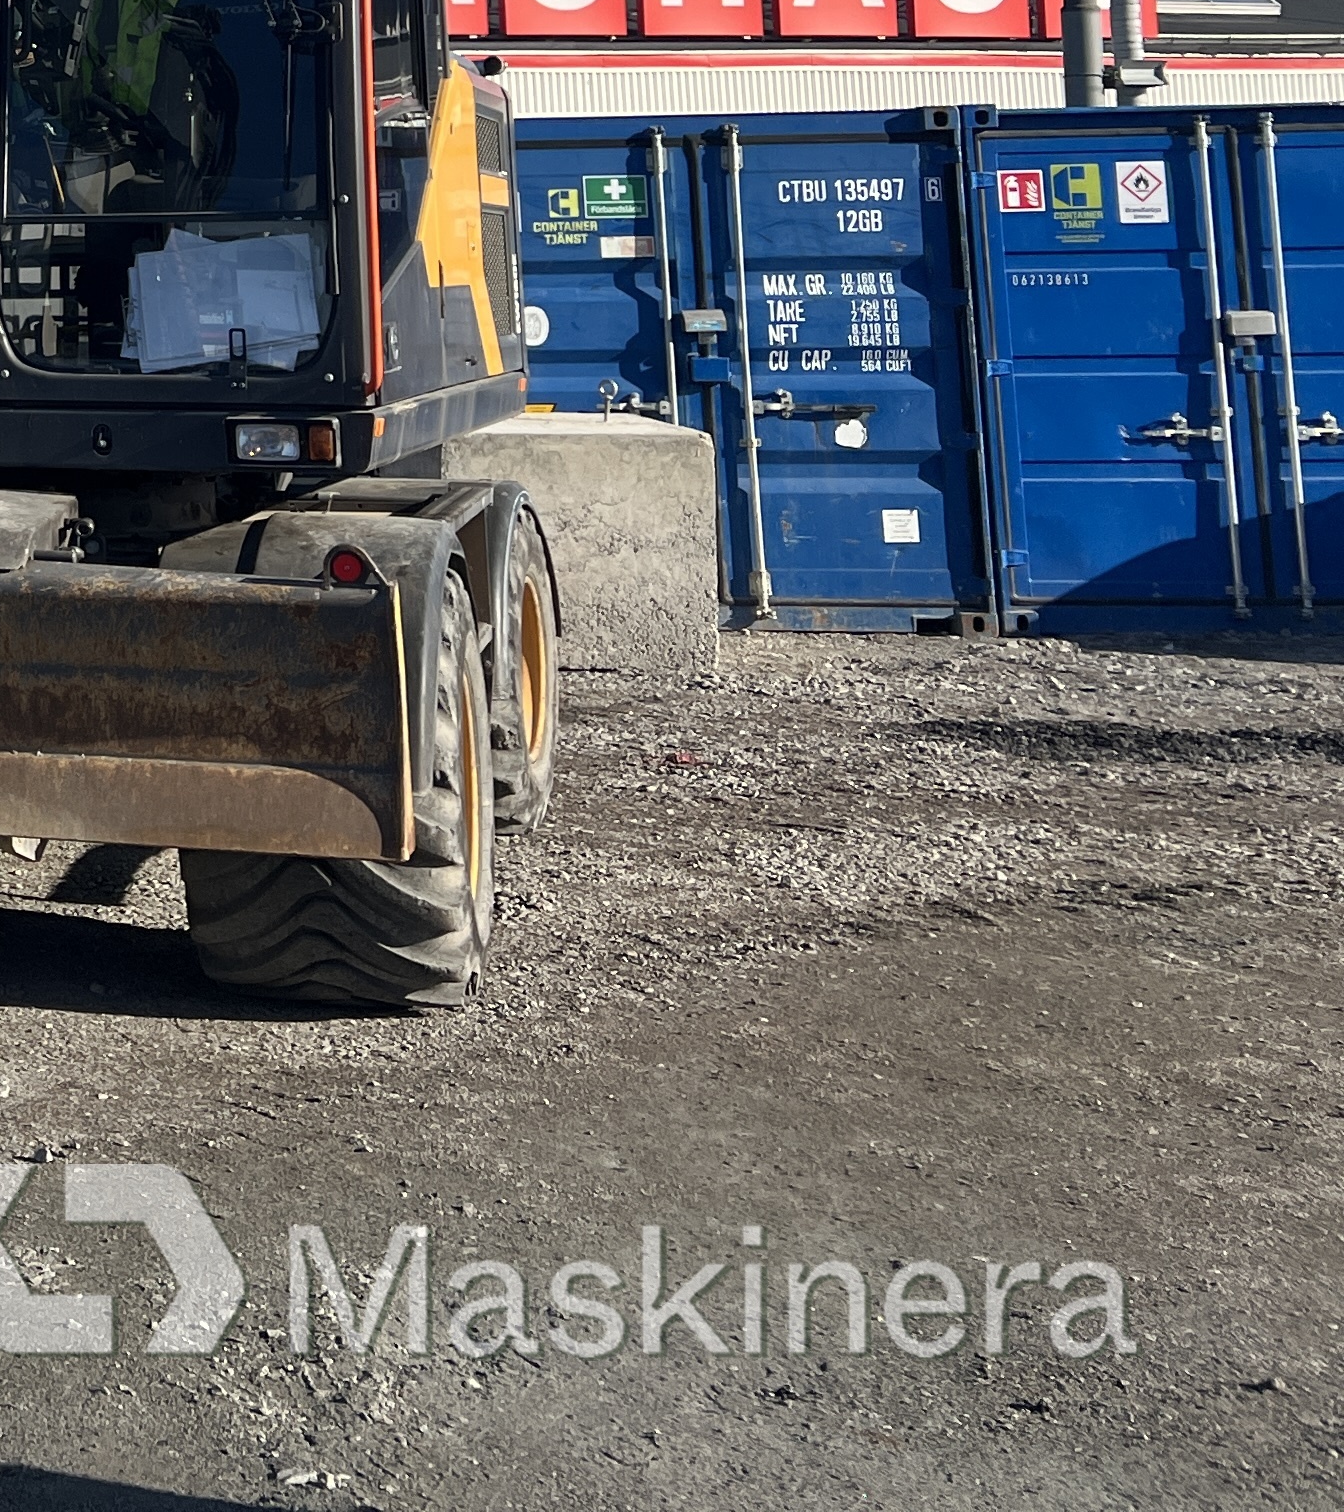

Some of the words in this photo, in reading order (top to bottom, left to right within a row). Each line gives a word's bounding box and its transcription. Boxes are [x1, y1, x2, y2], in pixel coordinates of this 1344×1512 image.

[777, 180, 827, 203] CTBU
[834, 178, 905, 202] 135497
[926, 178, 940, 200] 6
[533, 220, 598, 233] CONTAINER
[836, 209, 883, 233] 12GB
[878, 272, 893, 284] KG
[1012, 273, 1089, 286] 062138613
[879, 284, 896, 295] LB
[766, 299, 806, 322] TARE
[883, 298, 898, 310] KG
[884, 310, 899, 322] LB
[885, 323, 900, 335] KG
[886, 335, 901, 346] LB
[768, 349, 789, 371] CU
[801, 349, 838, 371] CAP.
[861, 360, 882, 372] 564
